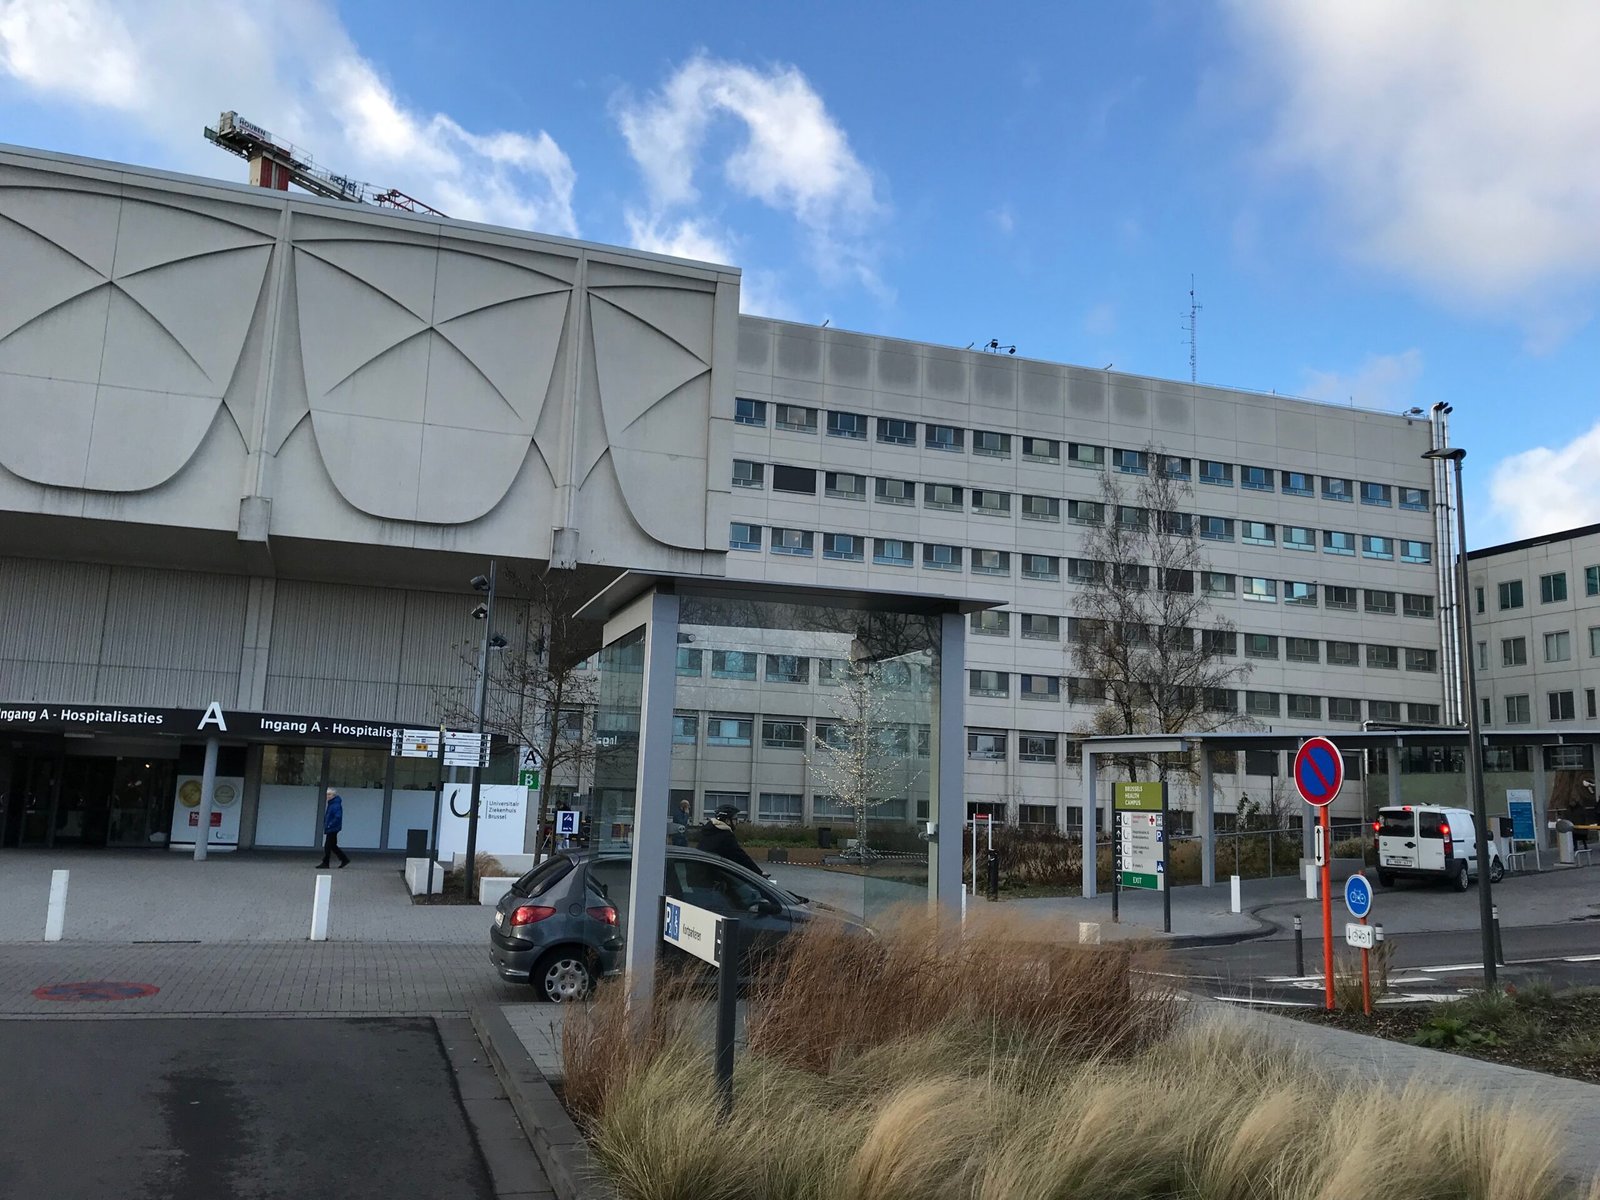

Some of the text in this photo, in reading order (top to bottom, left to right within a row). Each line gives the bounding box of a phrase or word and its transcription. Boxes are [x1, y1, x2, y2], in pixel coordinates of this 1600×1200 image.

[239, 118, 266, 136] HOUBEN
[0, 708, 36, 722] ngang
[39, 708, 49, 720] A
[60, 709, 163, 724] Hospitalisaties
[197, 701, 227, 731] A
[260, 718, 307, 734] Ingang
[311, 721, 321, 732] A
[332, 723, 396, 738] Hospitalis
[524, 750, 537, 765] A
[525, 773, 534, 786] B
[1132, 876, 1143, 884] EXIT
